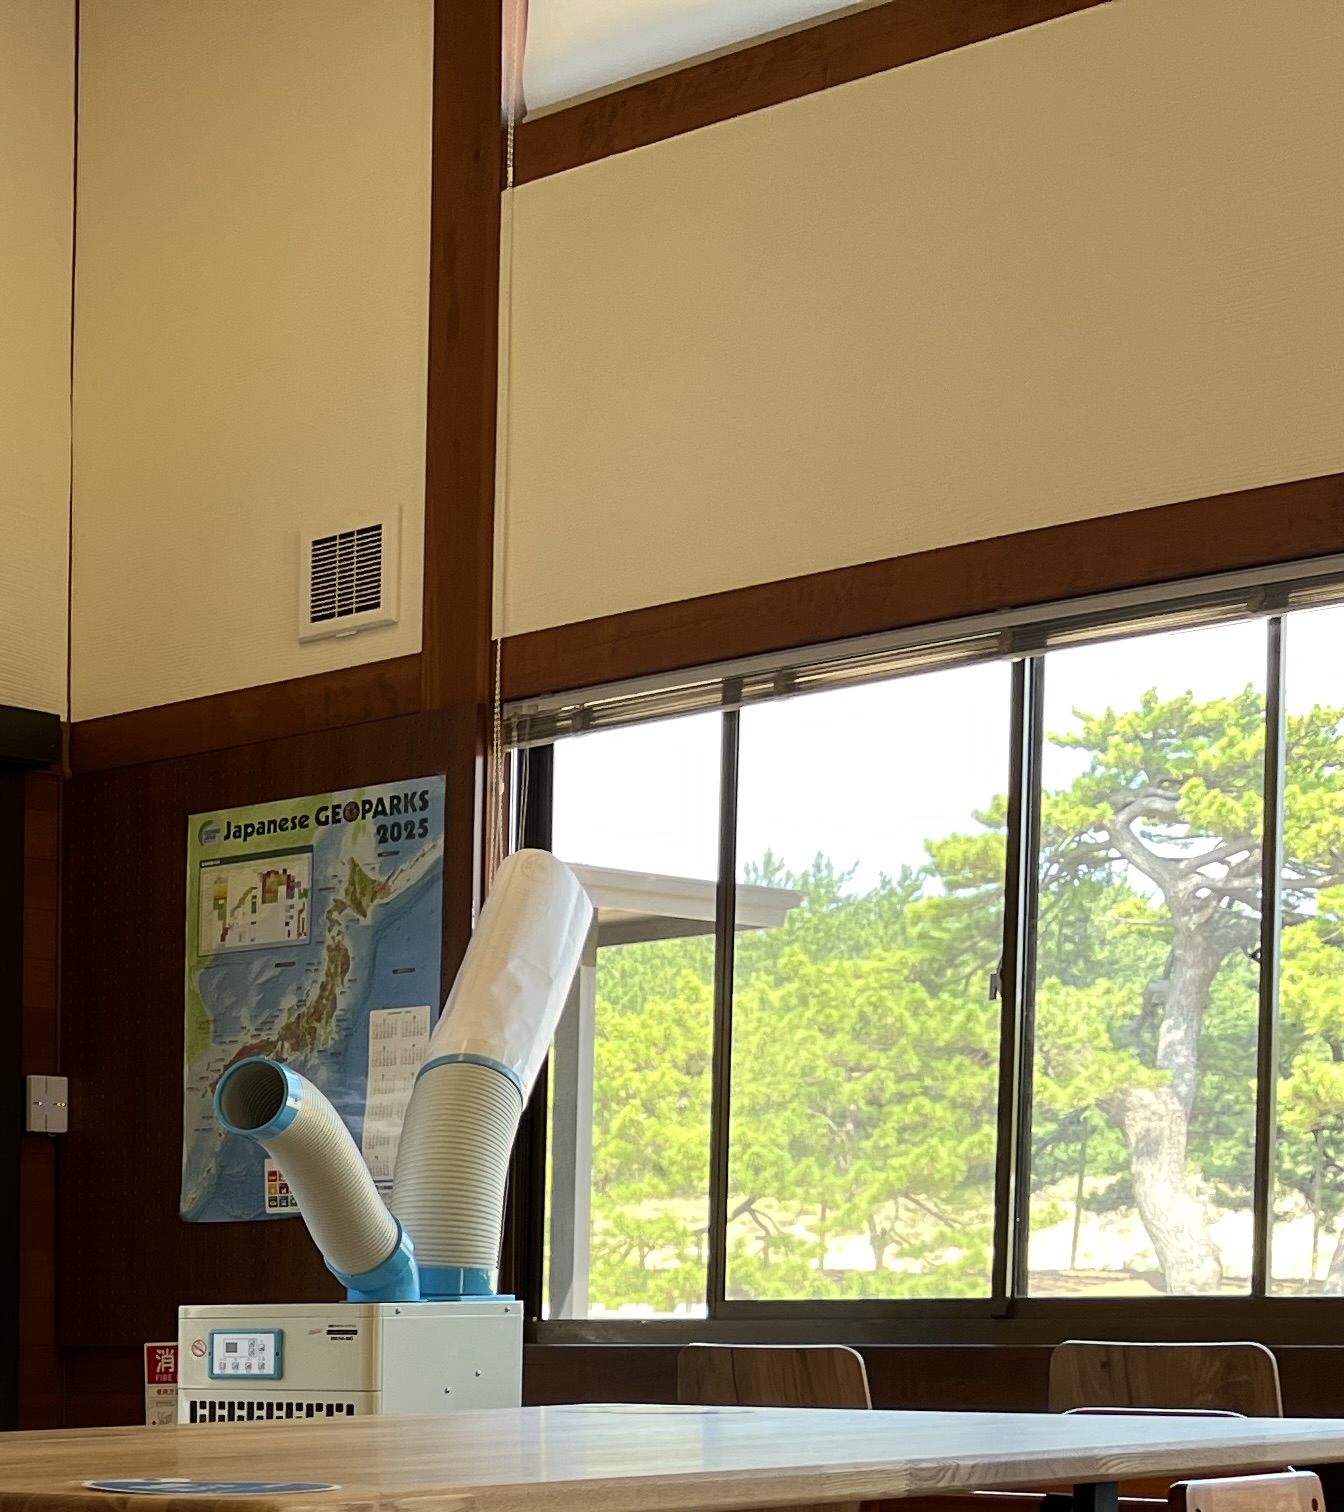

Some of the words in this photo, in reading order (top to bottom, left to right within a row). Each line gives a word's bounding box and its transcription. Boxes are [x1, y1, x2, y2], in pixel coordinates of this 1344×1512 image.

[223, 814, 310, 842] Japanese
[376, 817, 429, 845] 2025
[155, 1348, 175, 1373] 消
[155, 1374, 173, 1382] FIRE
